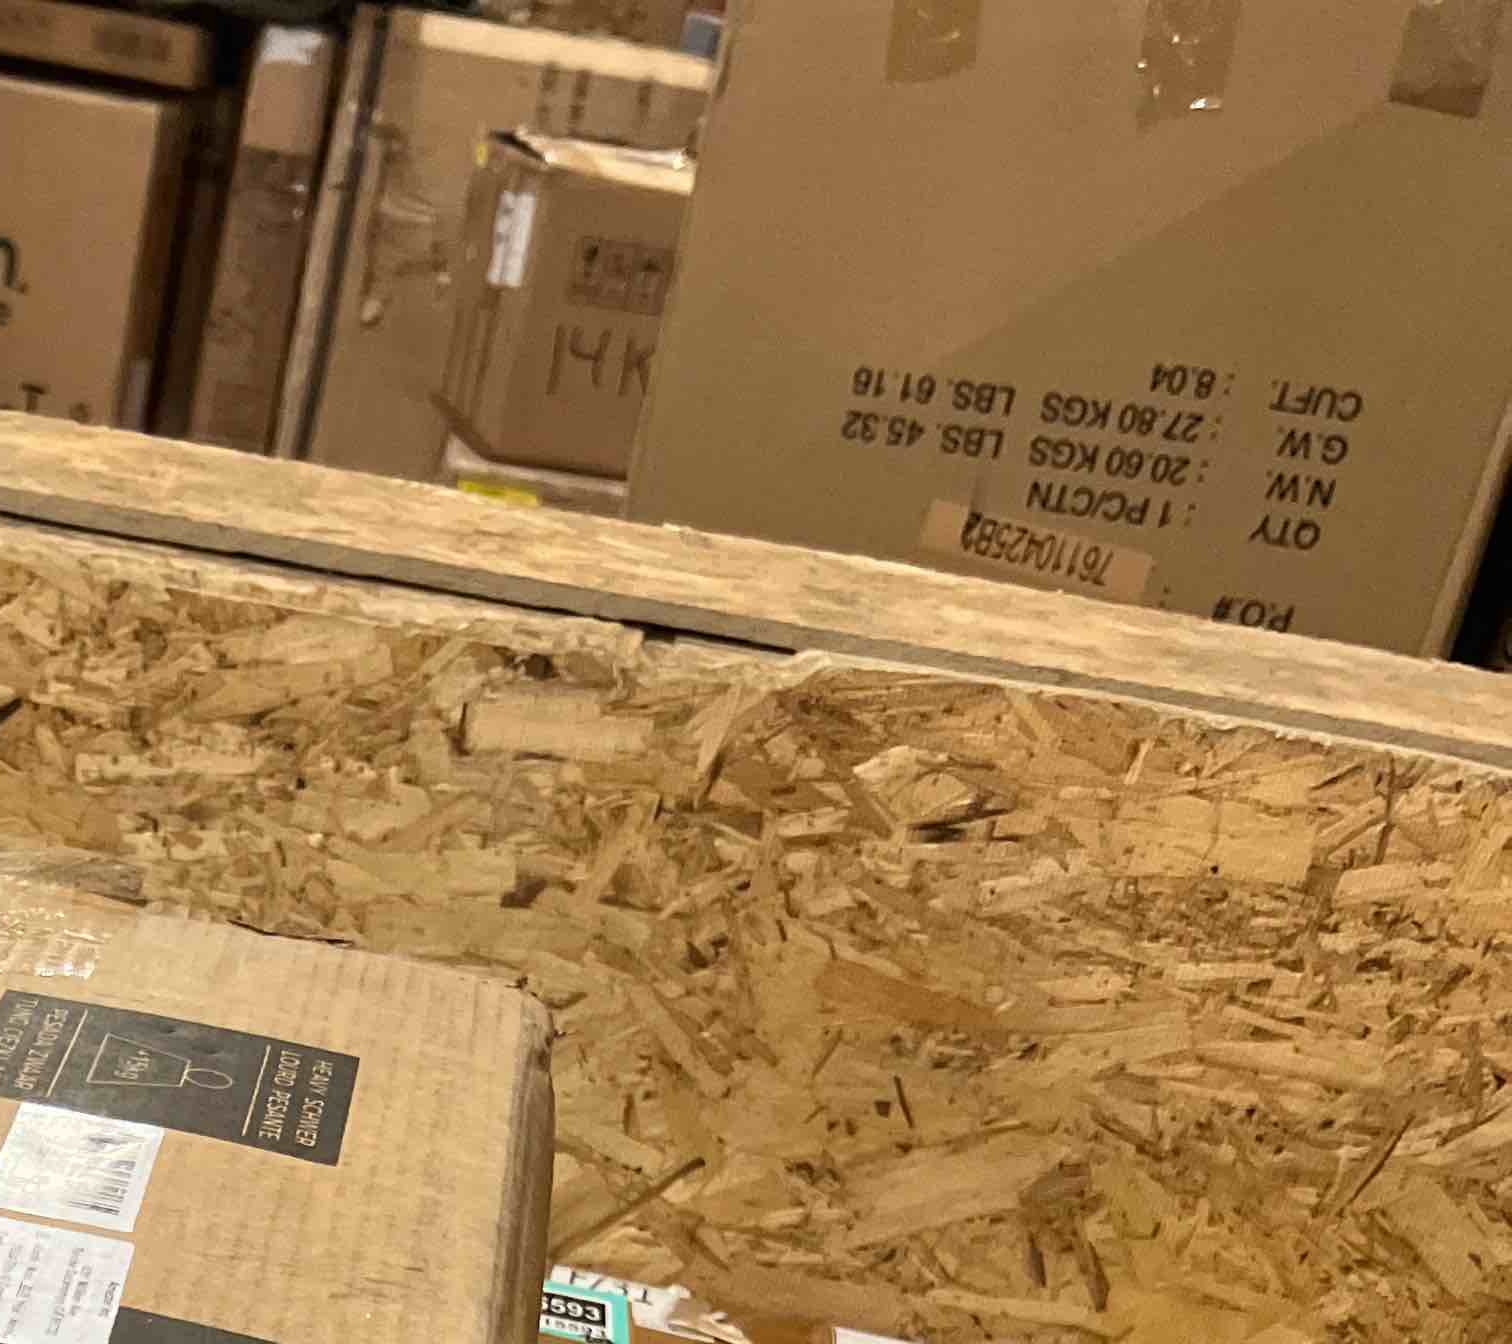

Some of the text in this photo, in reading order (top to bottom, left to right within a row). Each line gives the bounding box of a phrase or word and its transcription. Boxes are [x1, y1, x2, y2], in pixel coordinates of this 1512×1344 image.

[1041, 391, 1112, 426] KGS
[1028, 438, 1100, 472] KGS
[1025, 480, 1148, 526] PC/CTN
[1249, 516, 1322, 551] QTY
[259, 1049, 302, 1141] LOURD PESANTE
[296, 1058, 336, 1148] HEAVY SCHWER
